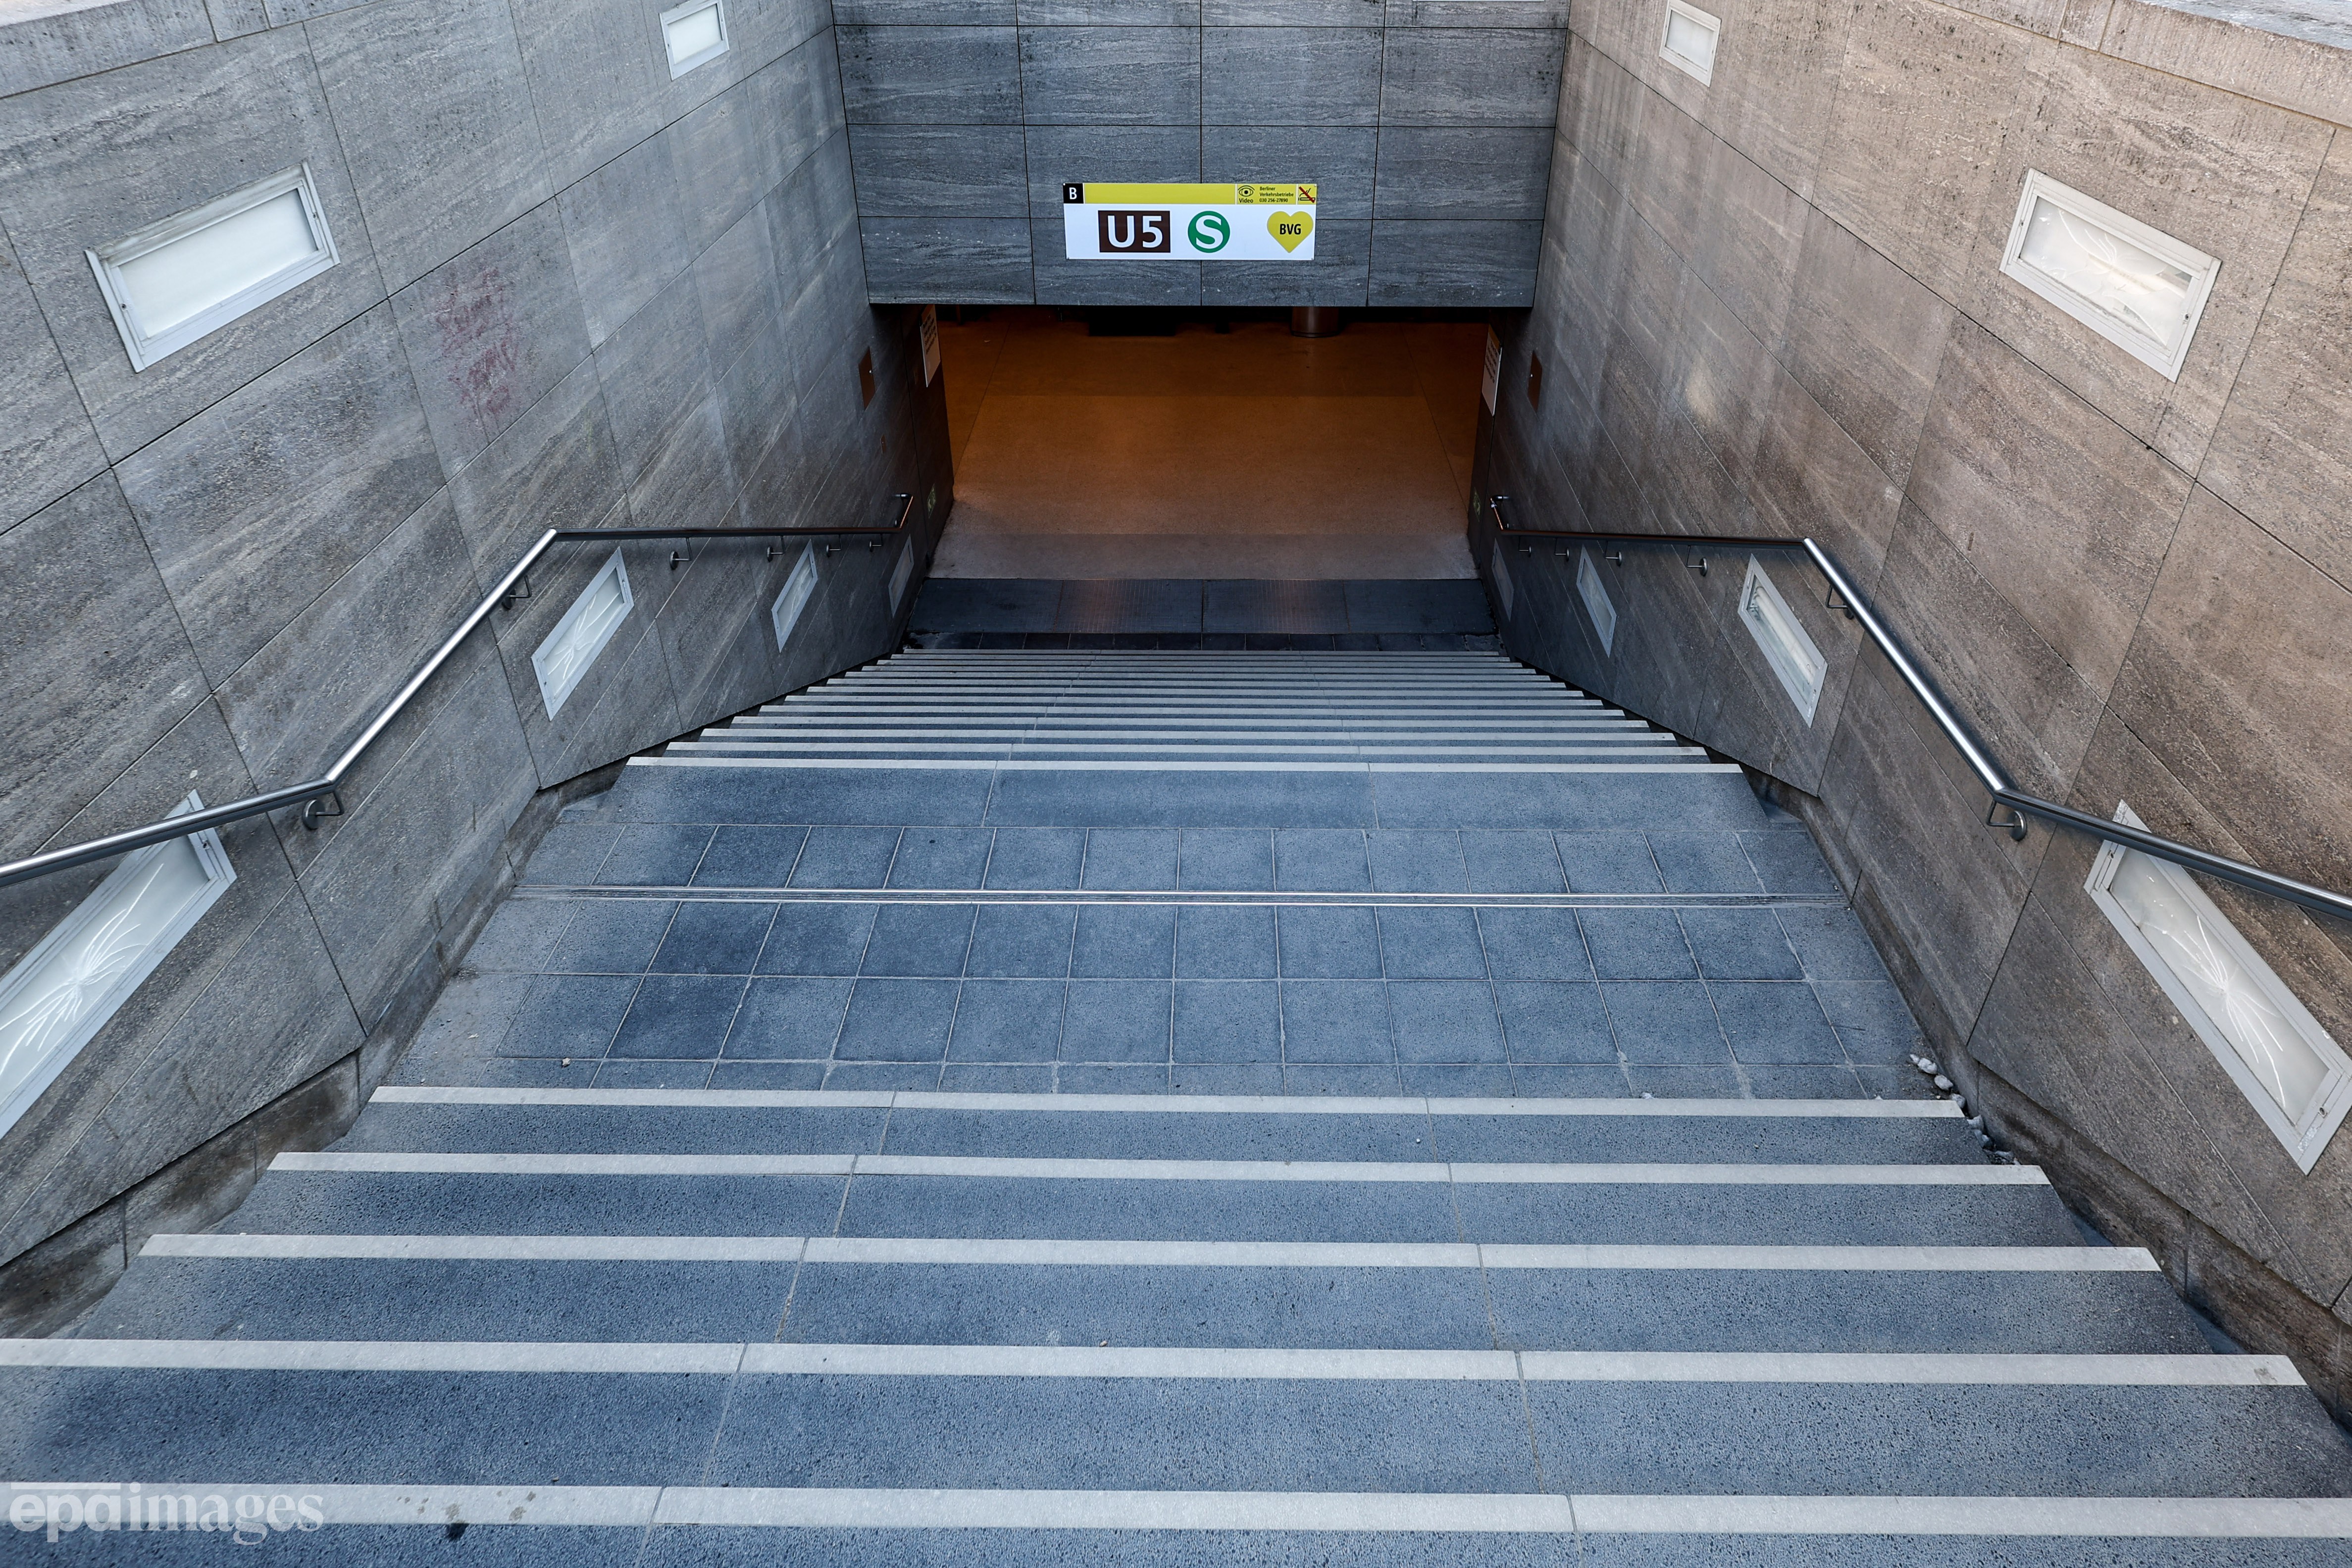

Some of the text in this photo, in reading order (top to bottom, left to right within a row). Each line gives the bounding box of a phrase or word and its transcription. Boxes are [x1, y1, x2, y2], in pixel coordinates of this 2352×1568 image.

[1069, 187, 1077, 200] B
[1107, 215, 1163, 248] U5
[1195, 215, 1224, 249] S
[1279, 224, 1301, 235] BVG
